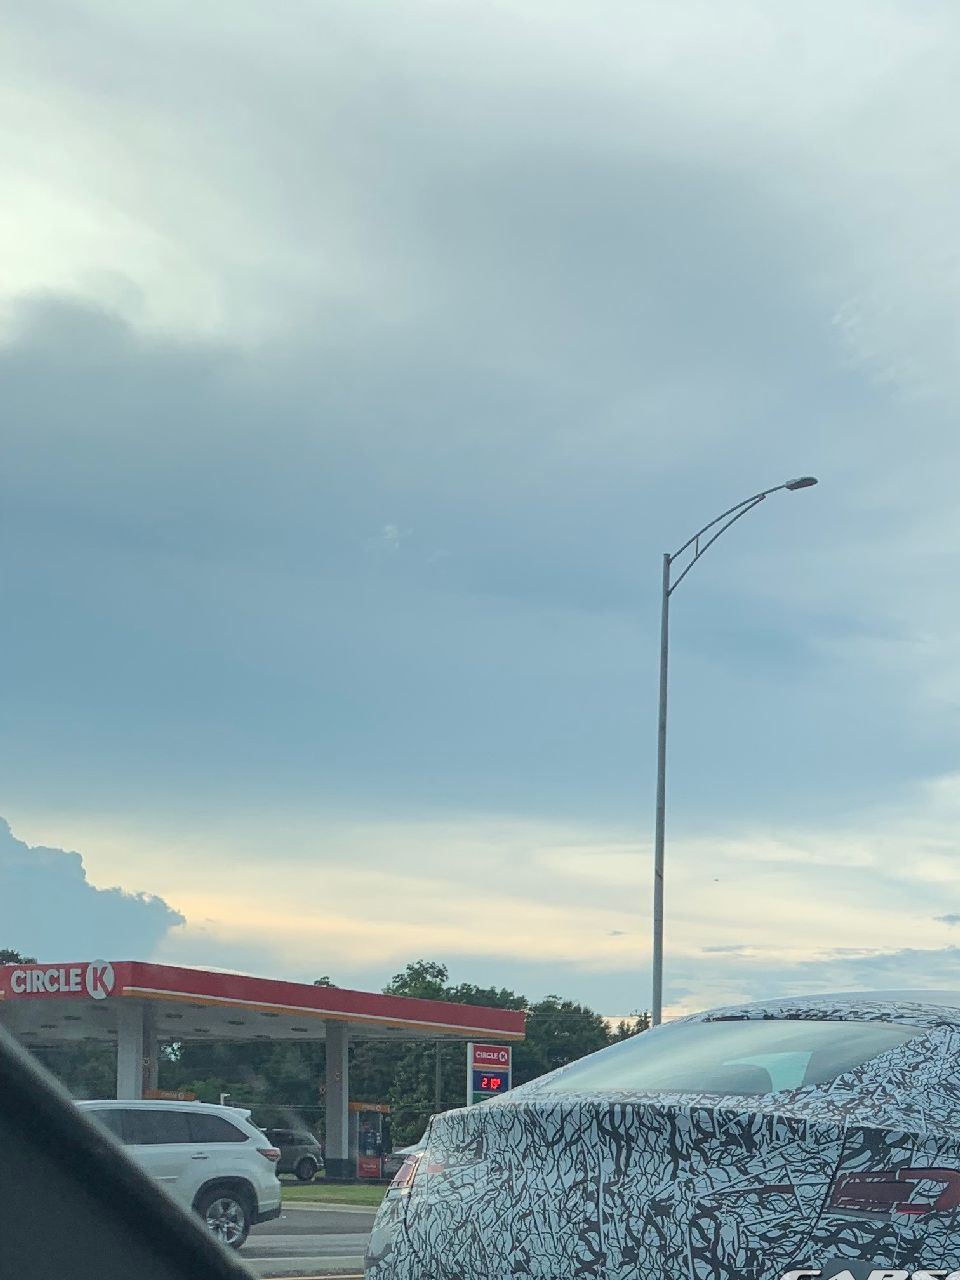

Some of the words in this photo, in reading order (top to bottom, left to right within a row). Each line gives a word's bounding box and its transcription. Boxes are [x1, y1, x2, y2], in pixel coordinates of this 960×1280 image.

[10, 968, 83, 993] CIRCLE
[90, 963, 113, 998] K
[476, 1051, 498, 1059] CIRCLE
